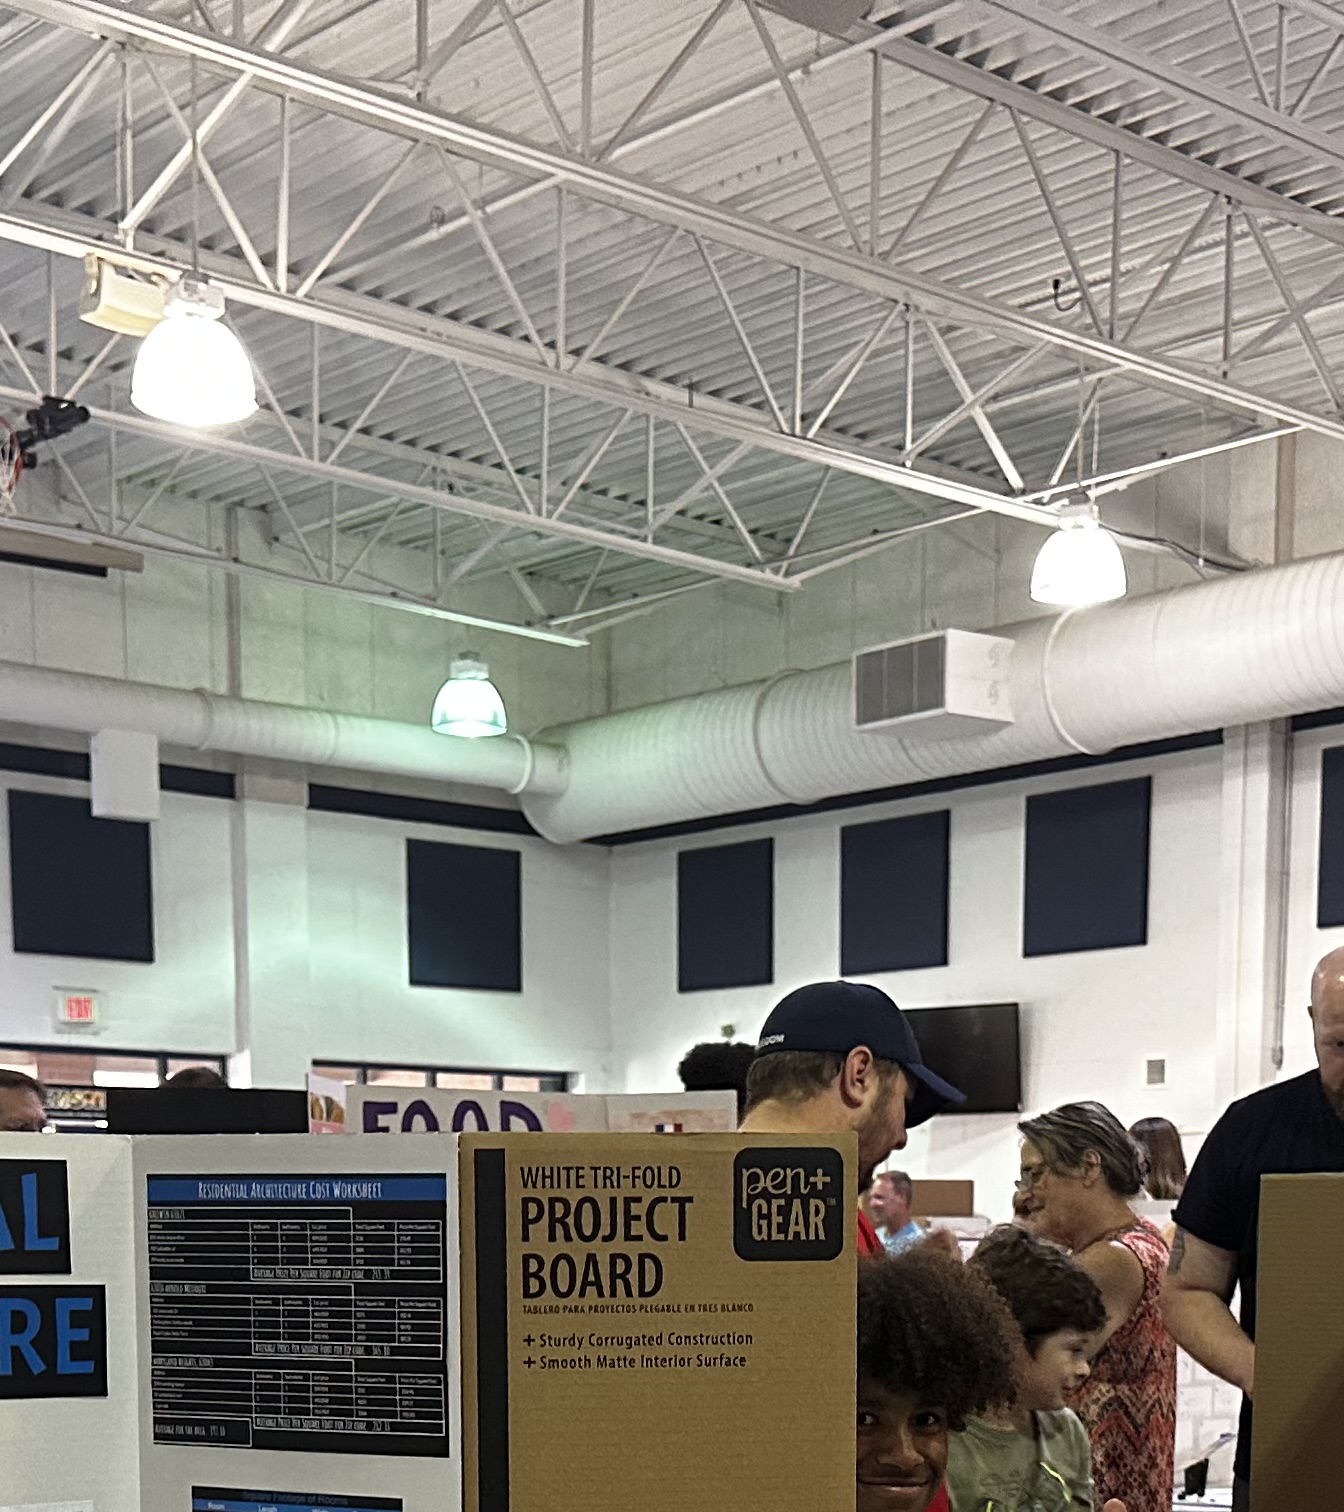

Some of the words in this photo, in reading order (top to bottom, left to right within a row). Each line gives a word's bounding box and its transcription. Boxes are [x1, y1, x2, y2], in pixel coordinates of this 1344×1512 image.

[520, 1166, 586, 1189] WHITE
[590, 1166, 682, 1189] TRI-FOLD
[741, 1166, 831, 1210] pen+
[521, 1196, 694, 1243] PROJECT
[751, 1198, 827, 1242] GEAR
[521, 1252, 664, 1299] BOARD
[522, 1305, 560, 1314] TABLERO
[562, 1305, 586, 1314] PARA
[588, 1304, 637, 1314] PROYECTOS
[639, 1304, 682, 1314] PLEGABLE
[685, 1304, 695, 1313] EN
[697, 1304, 718, 1313] TRES
[720, 1303, 754, 1313] BLANCO
[539, 1333, 585, 1350] Sturdy
[588, 1332, 664, 1350] Corrugated
[667, 1331, 753, 1347] Construction
[540, 1354, 592, 1371] Smooth
[596, 1355, 636, 1369] Matte
[640, 1354, 692, 1368] Interior
[696, 1353, 747, 1368] Surface
